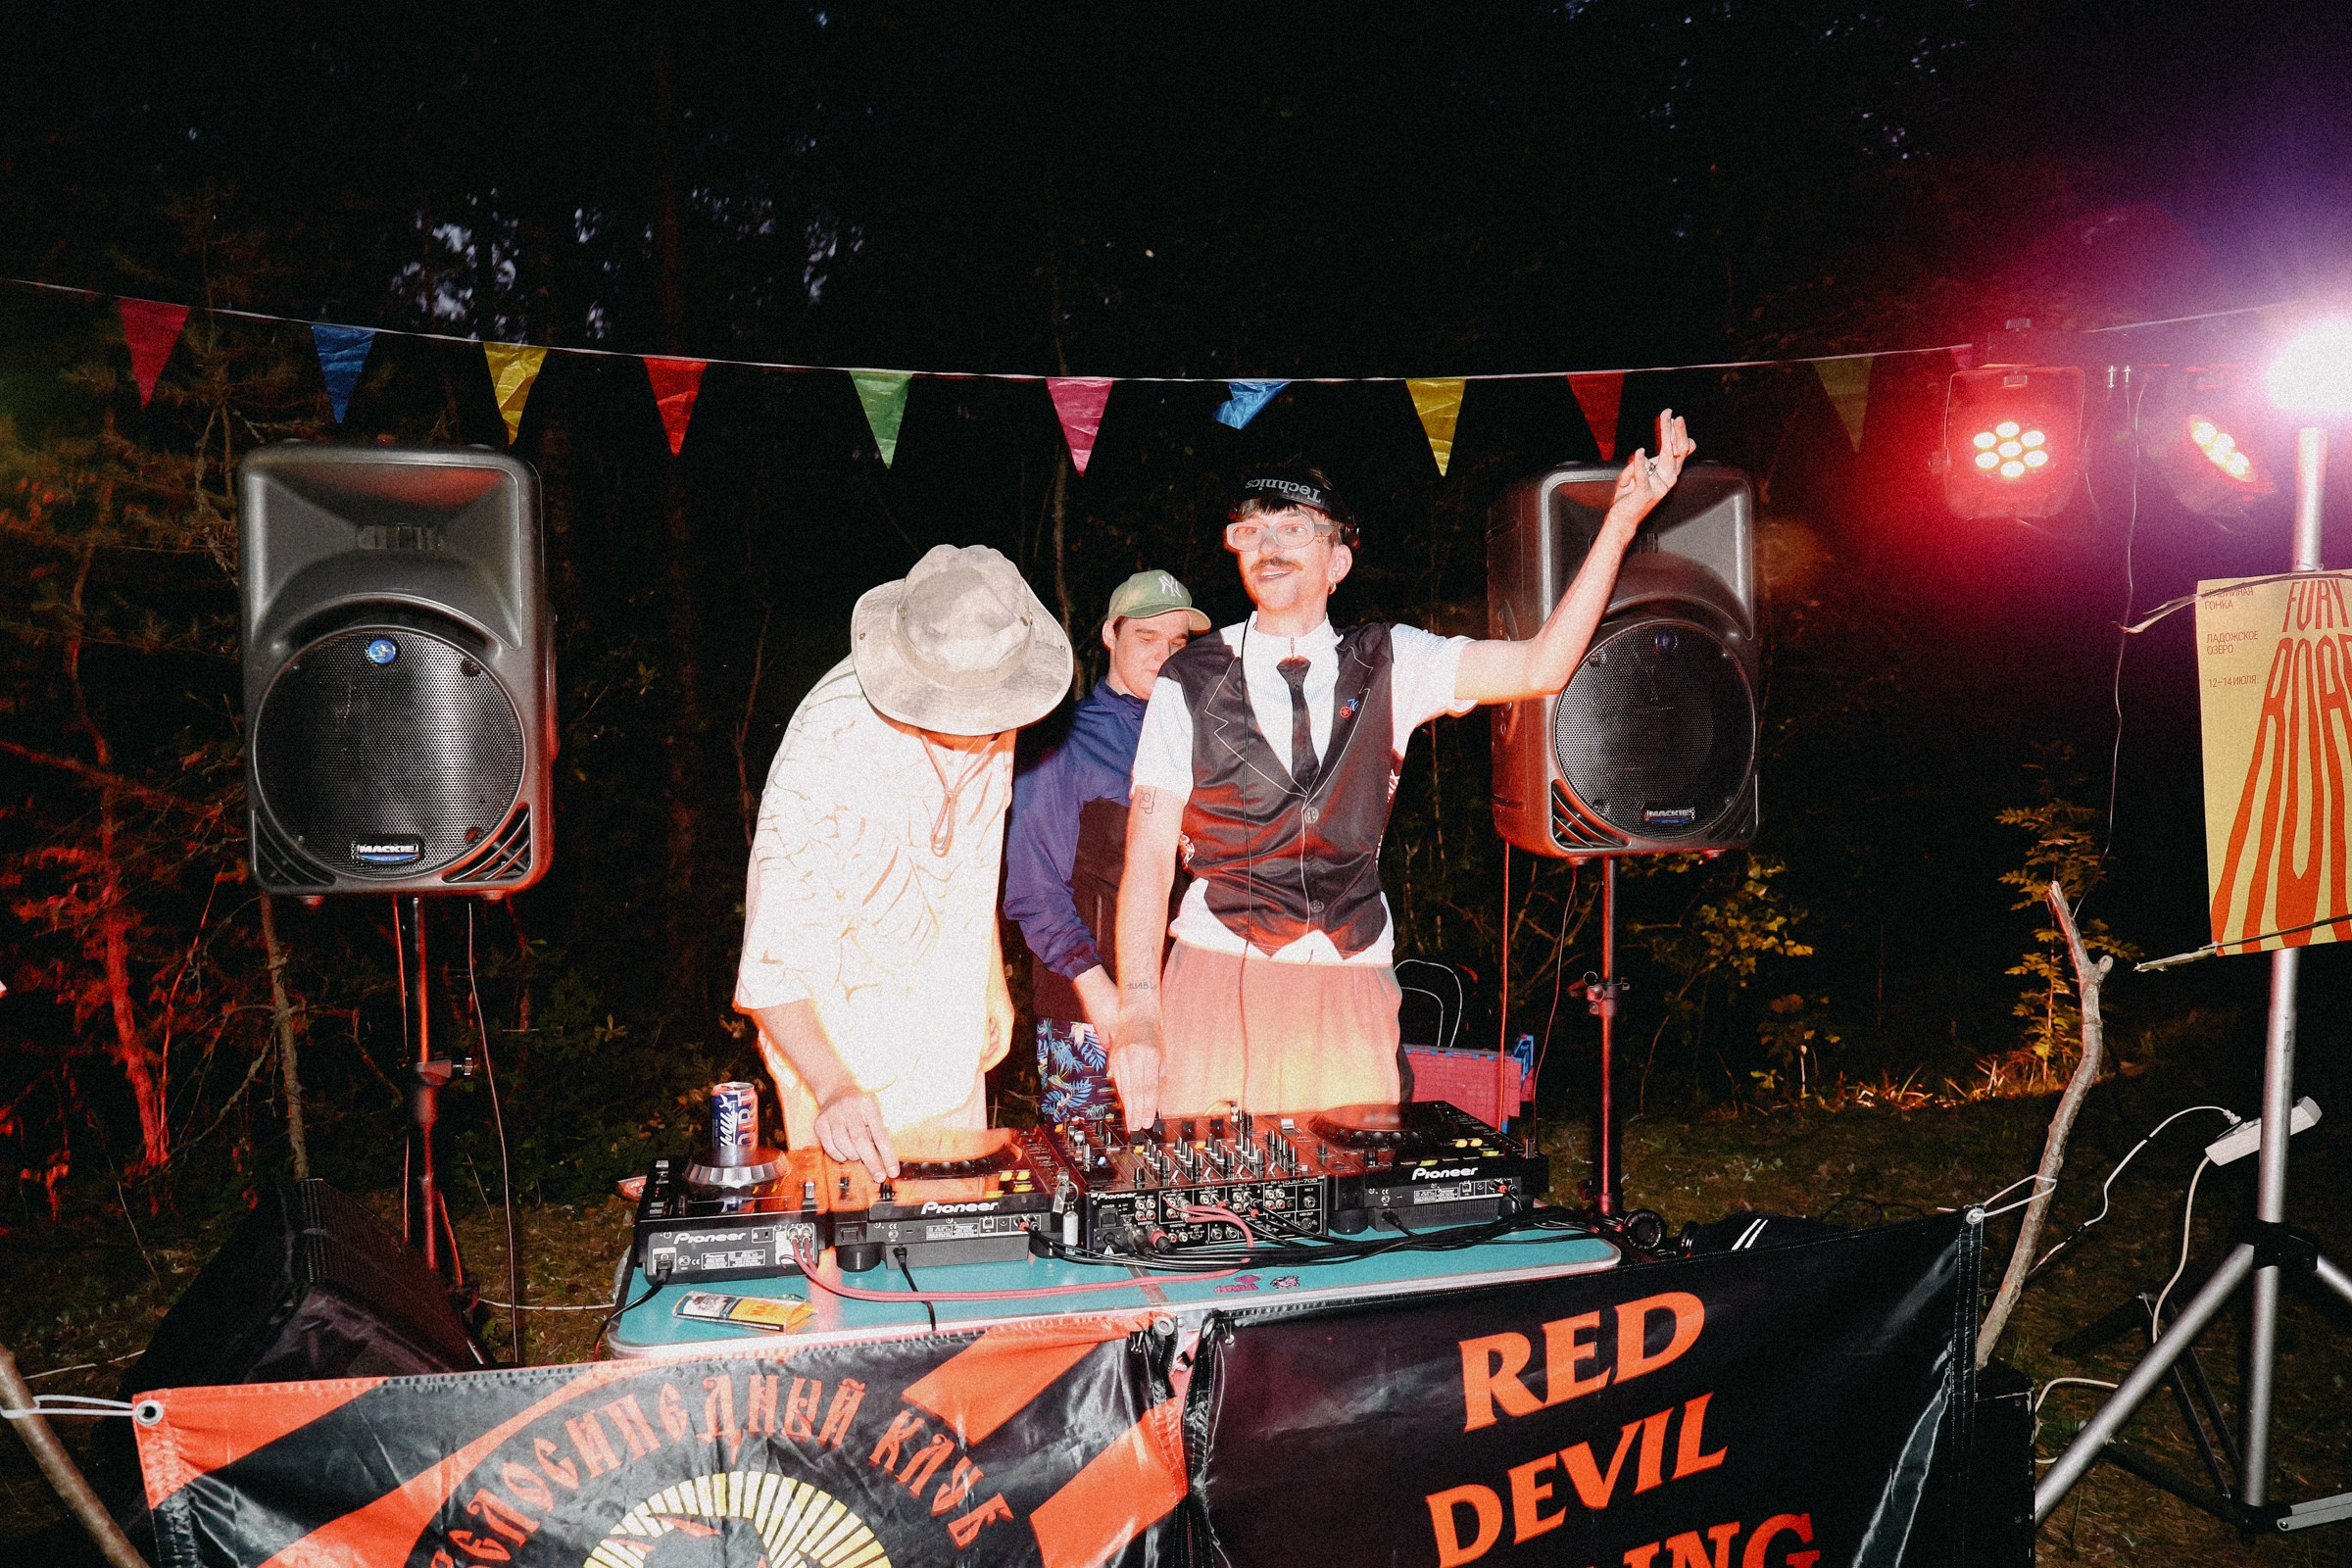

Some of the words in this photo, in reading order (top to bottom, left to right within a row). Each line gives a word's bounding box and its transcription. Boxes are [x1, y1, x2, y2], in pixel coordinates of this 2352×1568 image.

[1246, 478, 1322, 504] Technics
[2204, 599, 2234, 611] ГОНКА
[2281, 579, 2349, 633] FURY
[2207, 630, 2259, 644] ЛАДОЖСКОЕ
[2206, 644, 2234, 656] ОЗЕРО
[2232, 674, 2257, 686] ИЮЛЯ
[2211, 633, 2352, 956] ROA
[359, 844, 415, 854] MACKIE
[1411, 1166, 1479, 1181] Pioneer
[1097, 1192, 1138, 1200] Pioneer
[920, 1200, 999, 1215] Pioneer
[673, 1232, 747, 1245] Pioneer
[1458, 1291, 1705, 1433] RED
[1424, 1392, 1729, 1568] DEVIL
